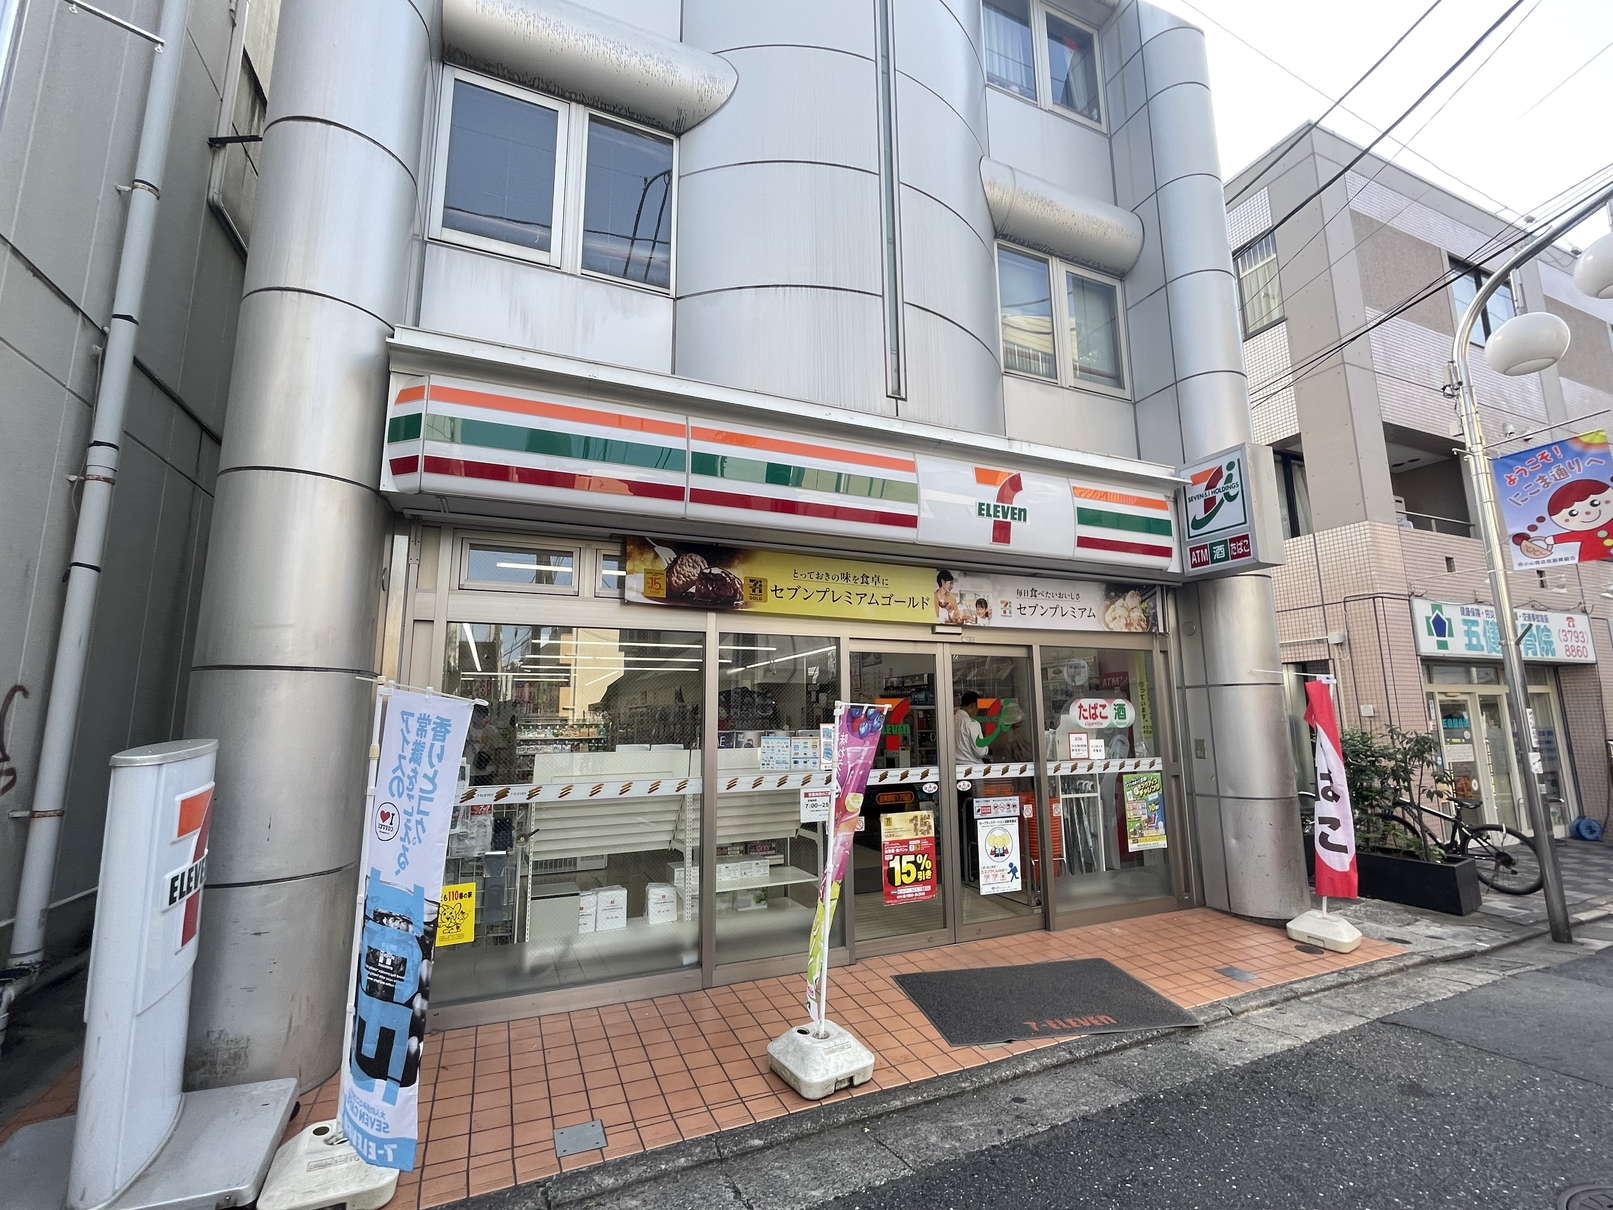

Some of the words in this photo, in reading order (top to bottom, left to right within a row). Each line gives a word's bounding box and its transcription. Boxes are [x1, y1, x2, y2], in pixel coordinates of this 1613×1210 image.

[1505, 446, 1562, 485] ようこそ！
[1508, 458, 1604, 506] にこま通りへ
[1191, 548, 1209, 564] ATM
[1212, 545, 1226, 559] 酒
[1230, 540, 1250, 555] たばこ
[792, 568, 889, 587] とっておきの味を食卓に
[769, 583, 930, 610] セブンプレミアムゴールド
[1016, 587, 1081, 601] 毎日食べたいおいしさ
[1016, 603, 1096, 619] セブンプレミアム
[1078, 703, 1109, 720] たばこ
[1114, 703, 1127, 720] 酒
[888, 853, 932, 887] 15%
